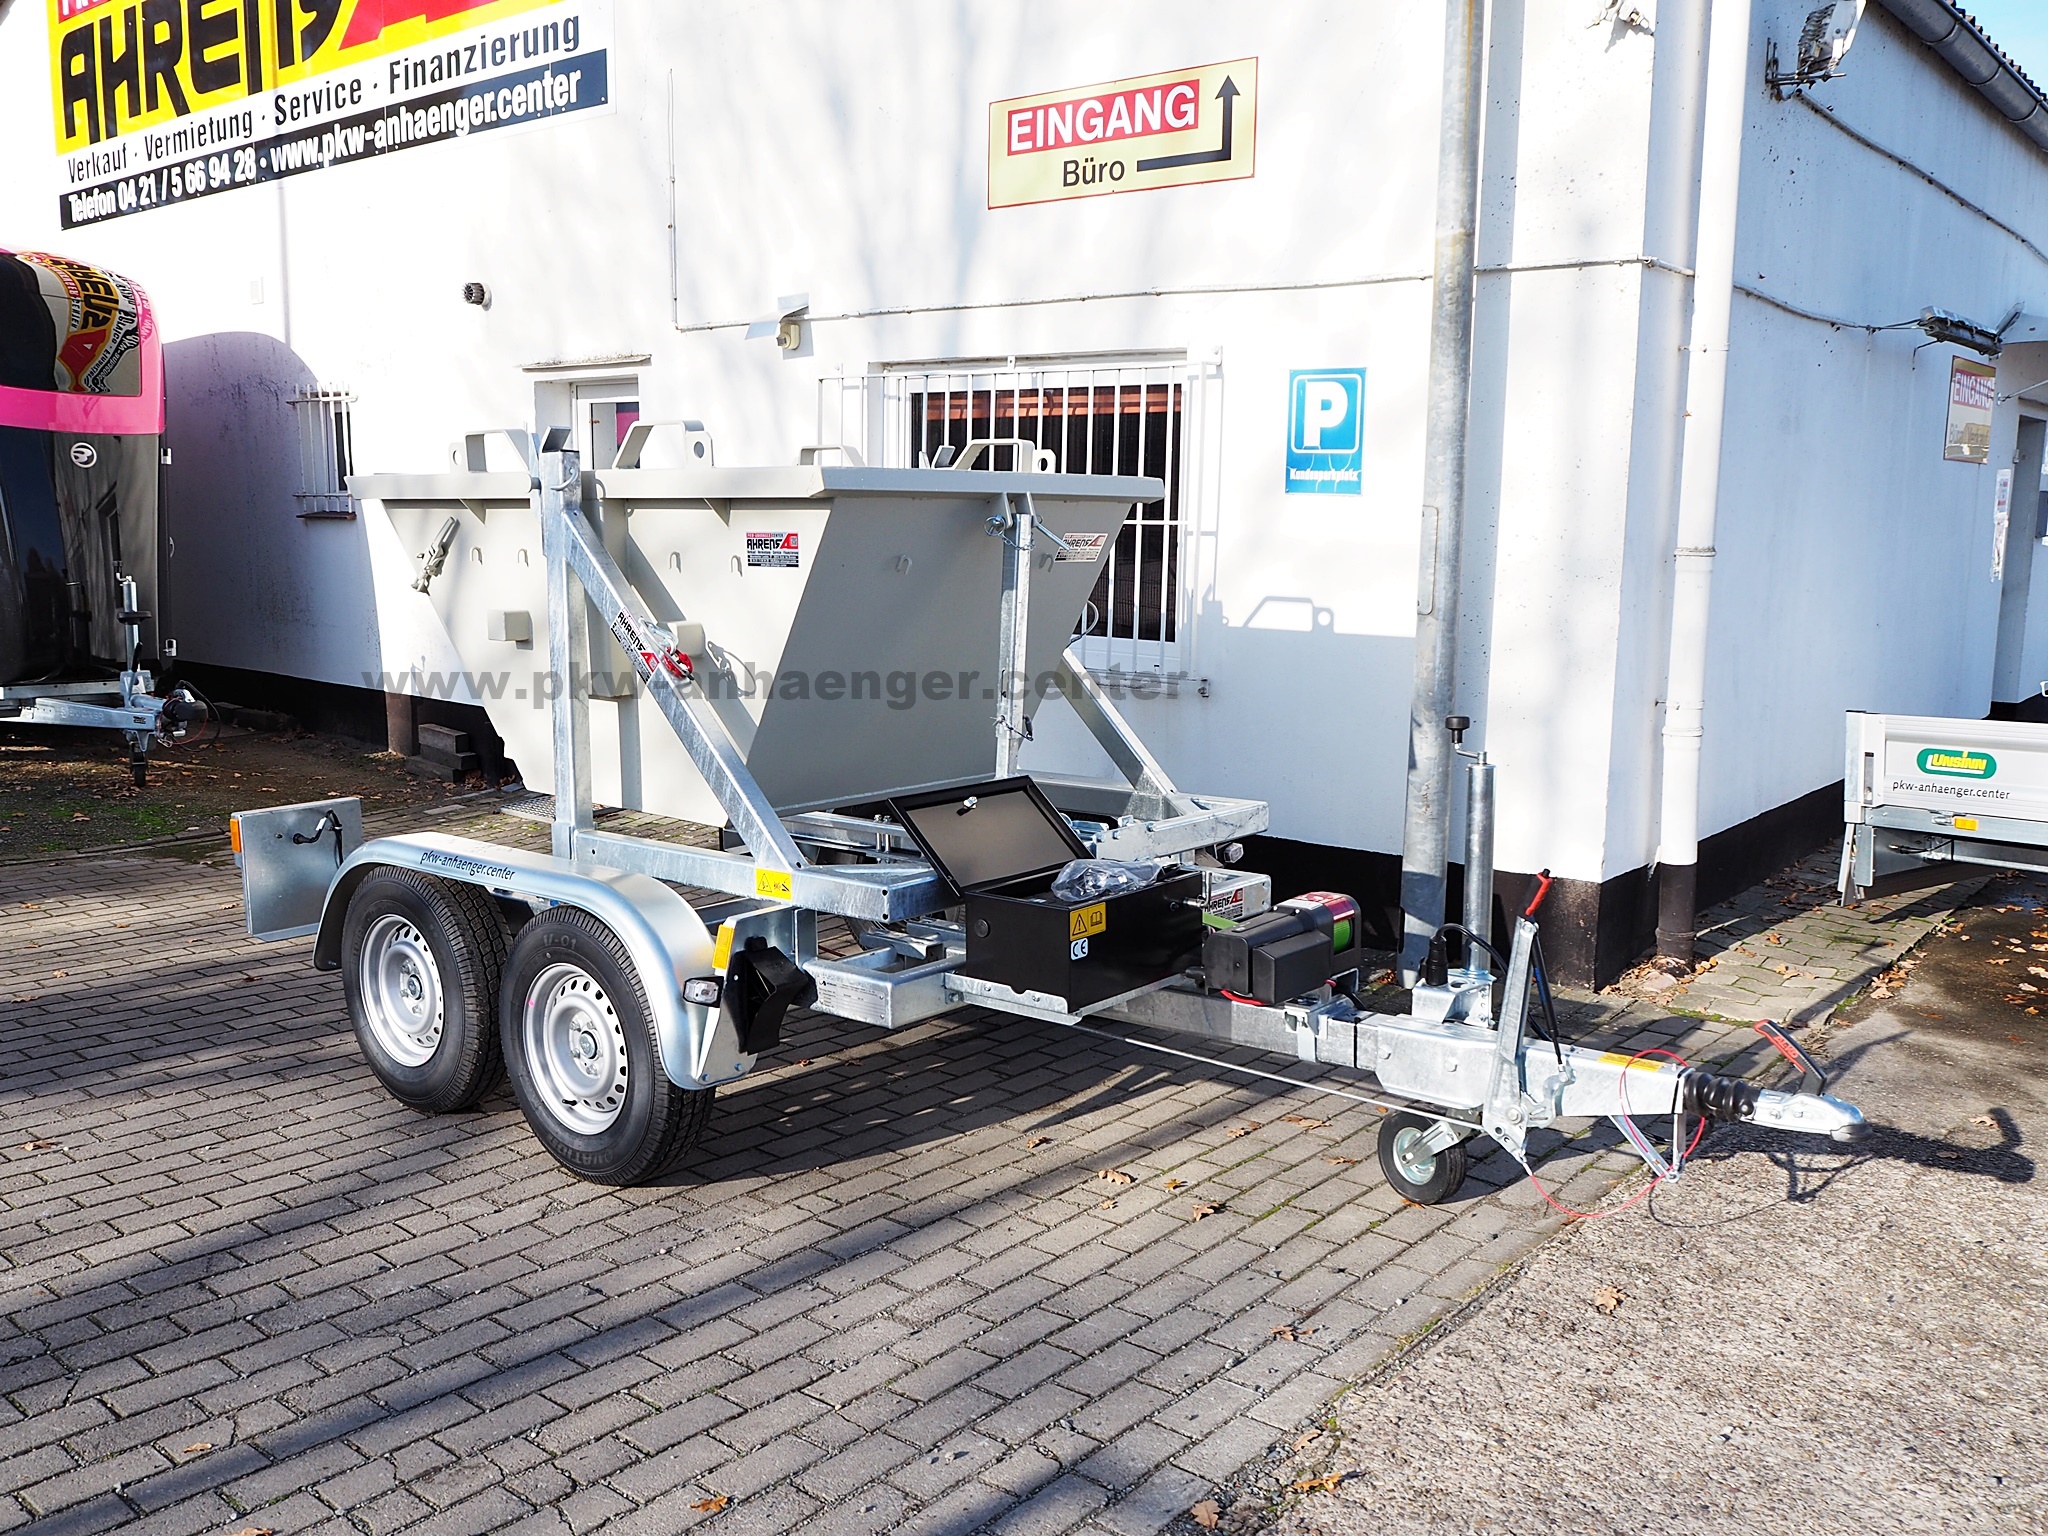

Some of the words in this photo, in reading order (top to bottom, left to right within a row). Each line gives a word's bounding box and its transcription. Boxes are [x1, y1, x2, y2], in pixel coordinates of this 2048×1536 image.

[67, 143, 128, 183] Verkauf
[144, 110, 253, 162] Vermietung
[274, 77, 362, 126] Service
[389, 15, 580, 95] Finanzierung
[1010, 83, 1196, 152] EINGANG
[68, 188, 117, 224] Telefon
[117, 178, 138, 211] 04
[139, 172, 157, 206] 21
[171, 165, 184, 198] 5
[184, 159, 206, 194] 66
[208, 153, 232, 189] 94
[234, 146, 257, 184] 28
[270, 63, 582, 174] www.pkw-anhaenger.center
[1062, 156, 1125, 188] Büro
[1303, 379, 1349, 448] P
[746, 539, 783, 550] AHRENS
[1892, 779, 2011, 800] pkw-anhaenger.center
[420, 850, 516, 880] pkw-anhaenger.center
